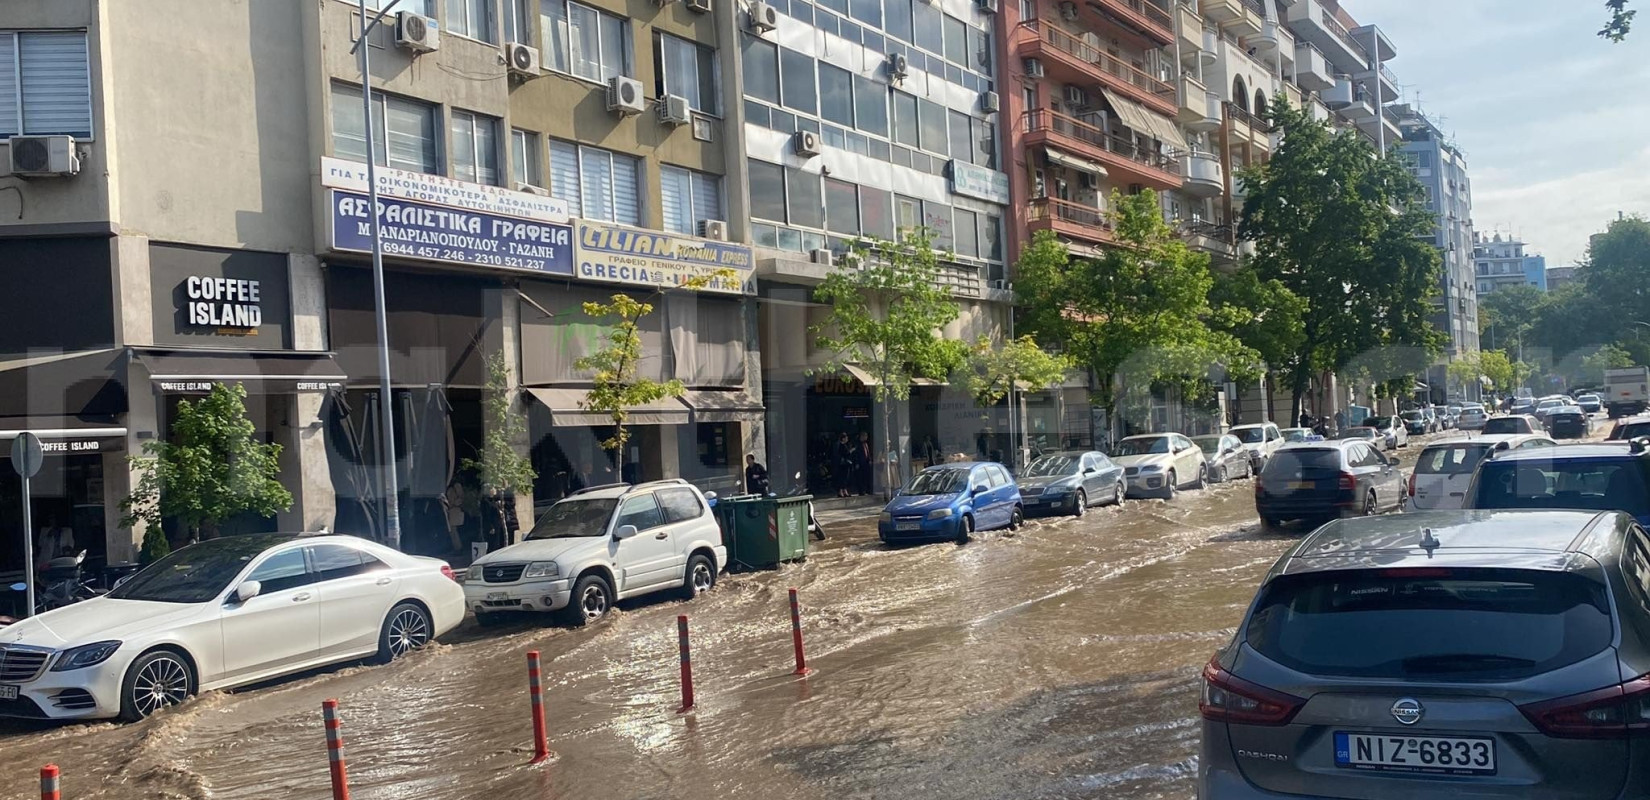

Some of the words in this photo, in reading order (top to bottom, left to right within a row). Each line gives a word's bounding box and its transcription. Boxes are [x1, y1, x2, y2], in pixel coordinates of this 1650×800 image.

[330, 168, 352, 179] ΓΙΑ
[379, 176, 488, 201] ΟΙΚΟΝΟΜΙΚΟΤΕΡΑ
[498, 197, 562, 214] ΑΣΦΑΛΙΣΤΡΑ
[376, 185, 395, 195] ΗΣ
[405, 191, 450, 204] ΑΓΟΡΑΣ
[338, 197, 481, 234] ΑΣΦΑΛΙΣΤΙΚΑ
[492, 219, 569, 245] ΓΡΑΦΕΙΑ
[379, 225, 499, 252] ΑΝΔΡΙΑΝΟΠΟΥΛΟΥ
[509, 242, 554, 259] ΓΑΖΑΝΗ
[583, 226, 674, 256] LILIAN
[383, 242, 415, 255] 6944
[417, 246, 465, 260] 457.246
[475, 253, 502, 265] 2310
[505, 256, 545, 270] 521.237
[608, 255, 647, 266] ΓΡΑΦΕΙΟ
[651, 260, 686, 271] ΓΕΝΙΚΟΥ
[581, 262, 649, 282] GRECIA
[187, 275, 260, 302] COFFEE
[189, 301, 262, 327] ISLAND
[161, 382, 186, 391] COFFEE
[187, 382, 212, 391] ISLAND
[297, 382, 318, 390] COFFEE
[71, 441, 99, 451] ISLAND
[1351, 587, 1389, 595] NISSAN
[1238, 749, 1288, 761] QASHQAI
[1337, 750, 1349, 759] GR
